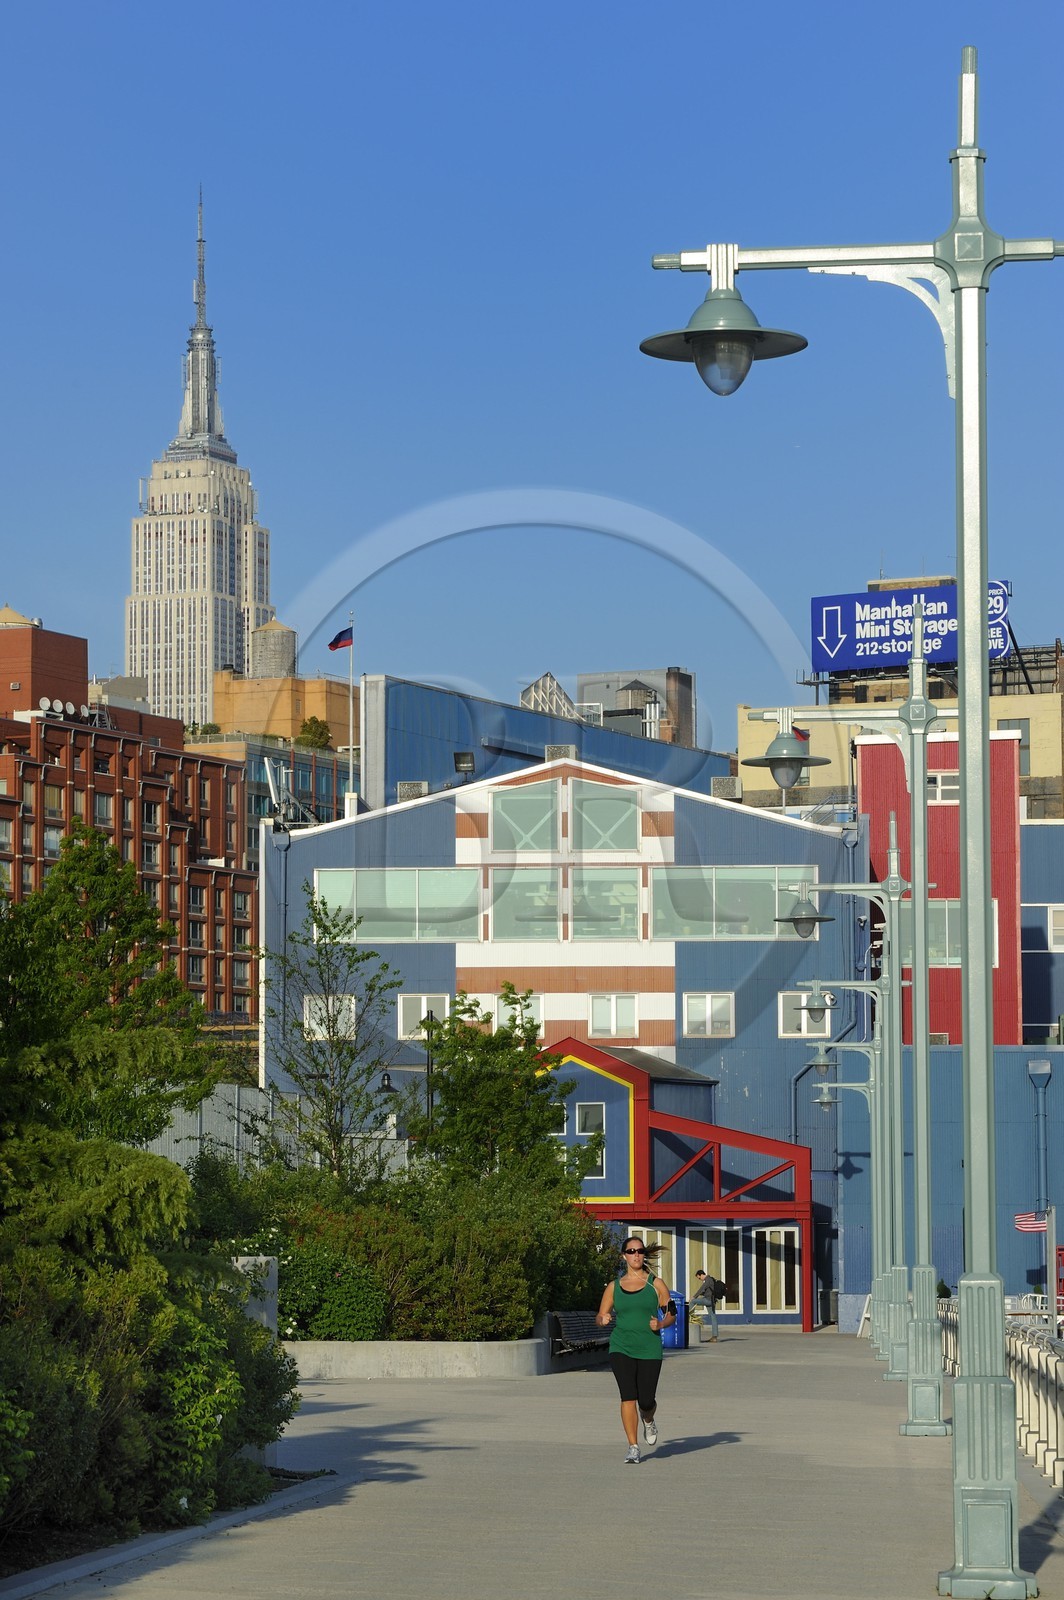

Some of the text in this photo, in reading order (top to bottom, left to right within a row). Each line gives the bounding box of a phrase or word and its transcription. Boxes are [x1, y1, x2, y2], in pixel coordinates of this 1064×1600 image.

[855, 594, 948, 621] Manhattan
[855, 618, 958, 639] Mini Strage
